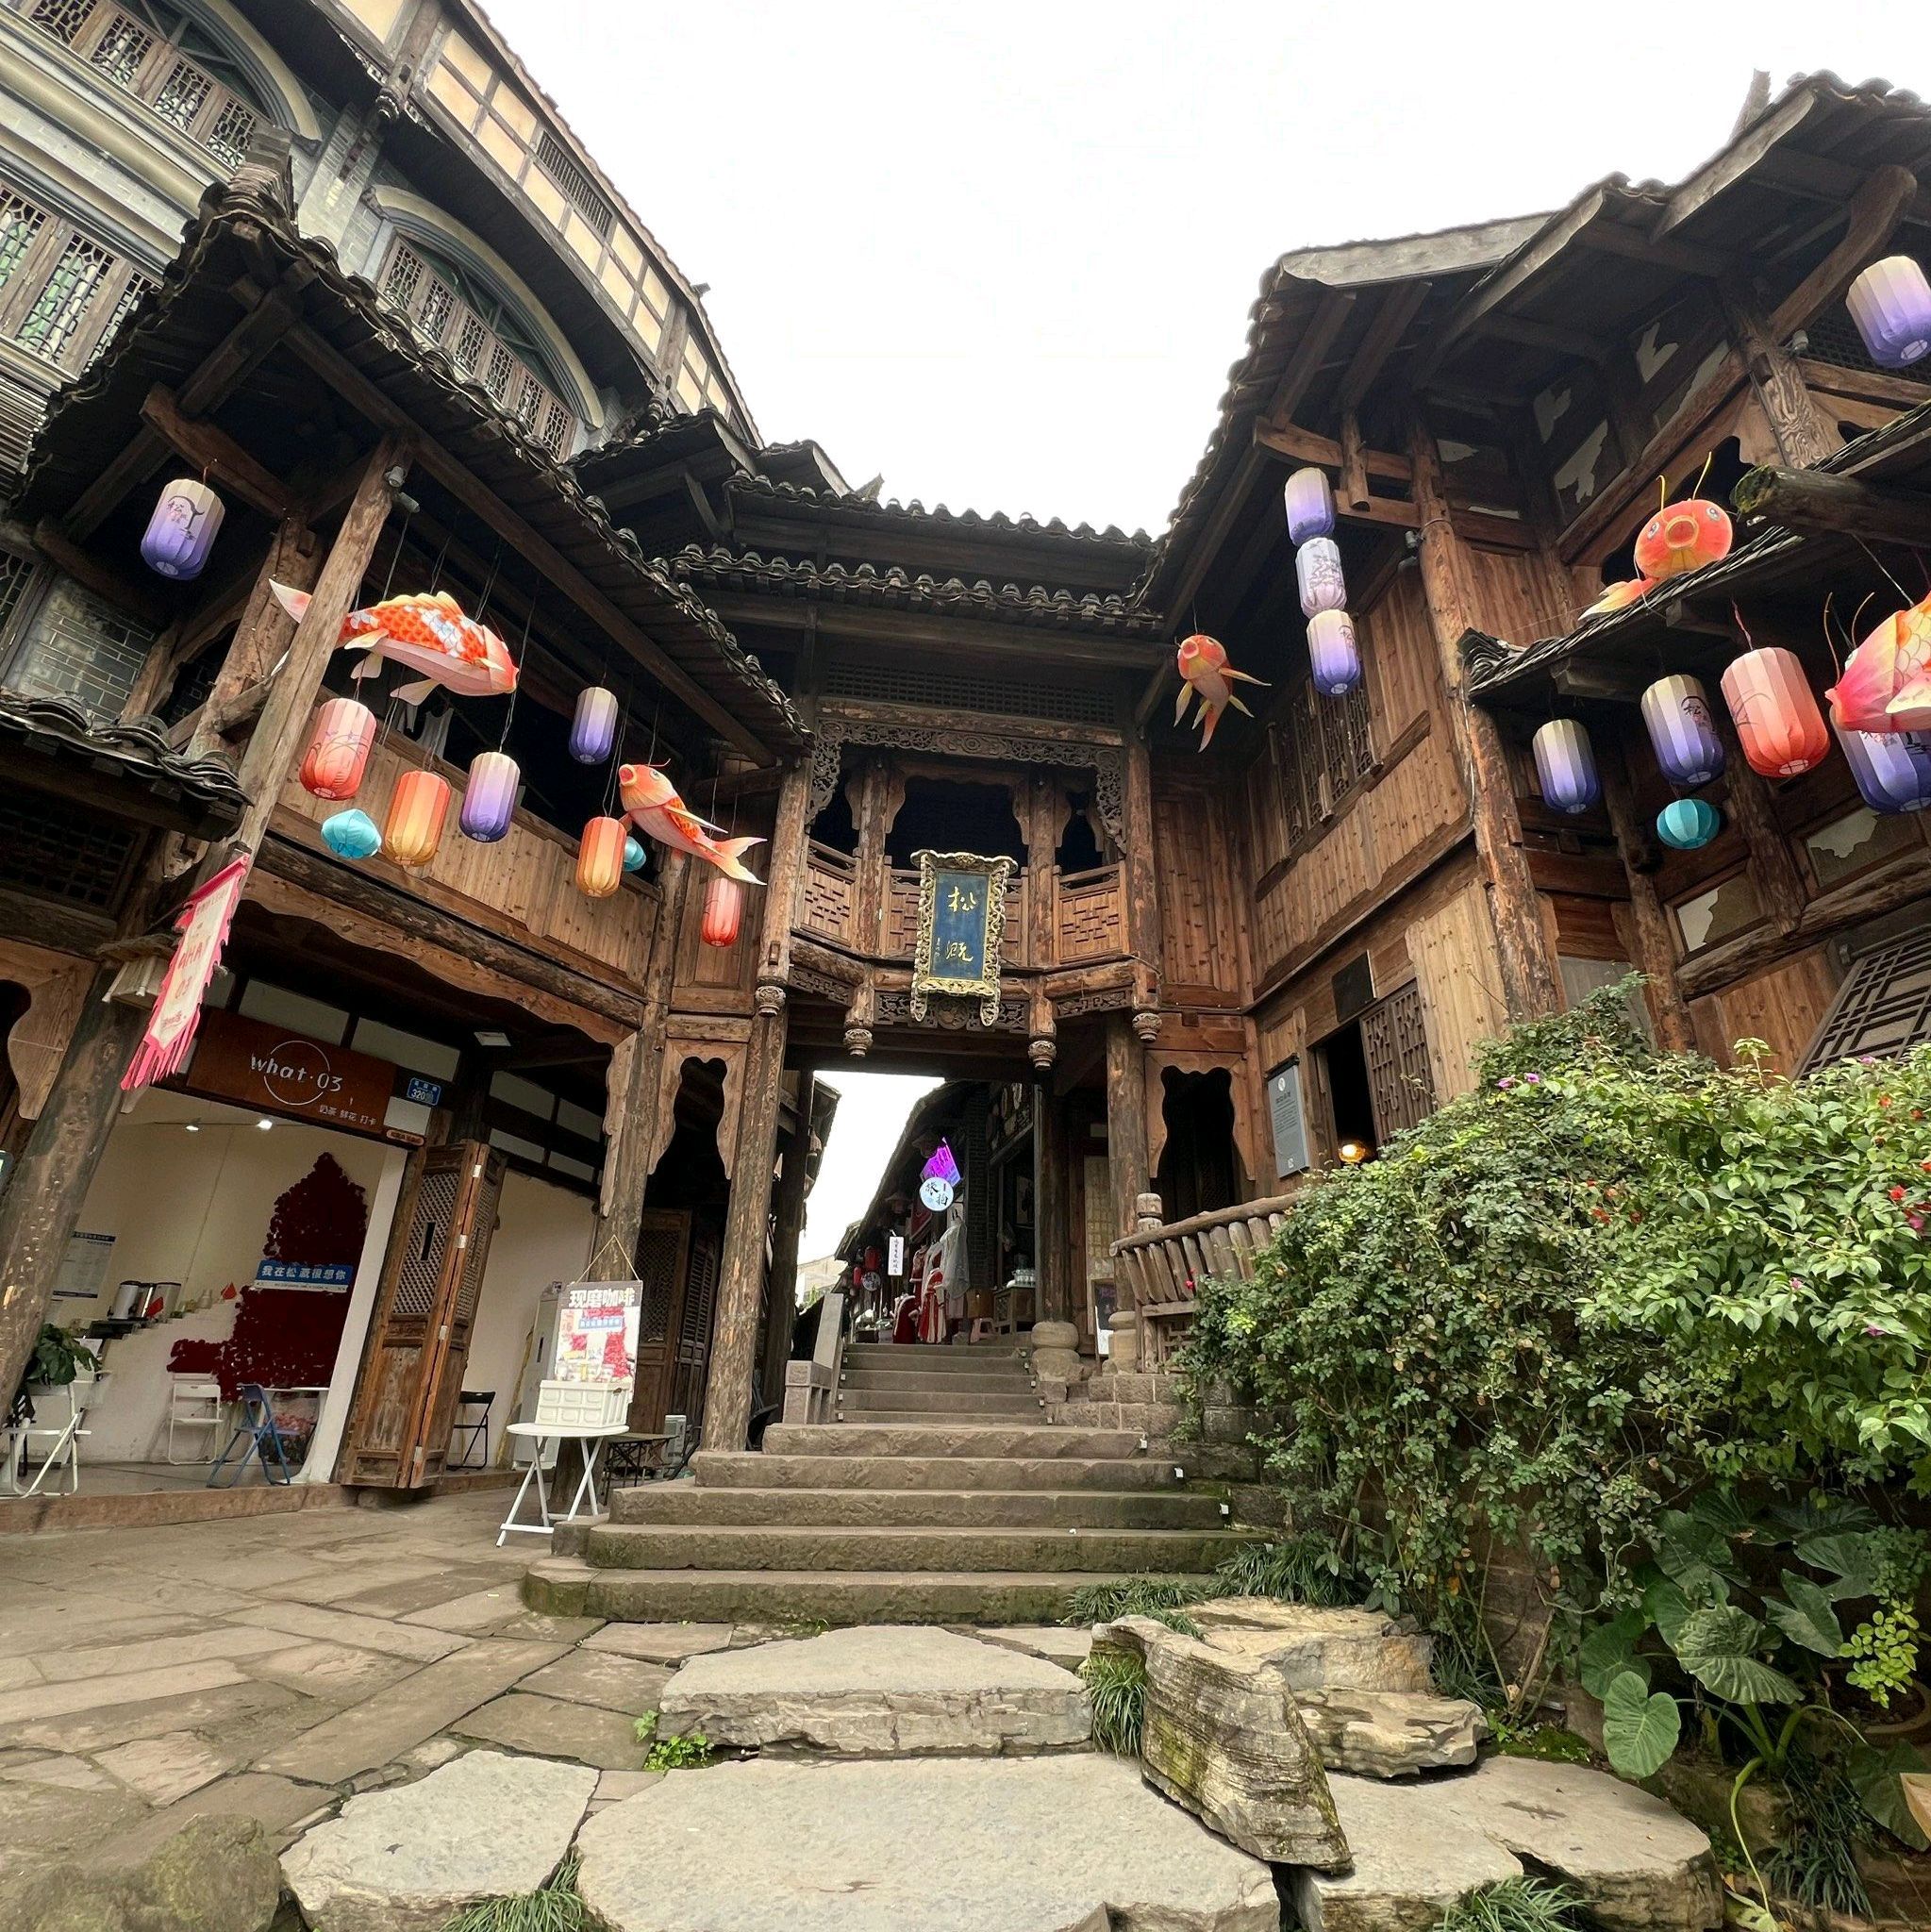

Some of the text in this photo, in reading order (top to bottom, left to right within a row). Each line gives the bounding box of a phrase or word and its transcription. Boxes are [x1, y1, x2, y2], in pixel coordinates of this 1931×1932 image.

[319, 1104, 377, 1126] 奶茶 鲜花 打卡
[568, 1287, 636, 1309] 现磨咖啡
